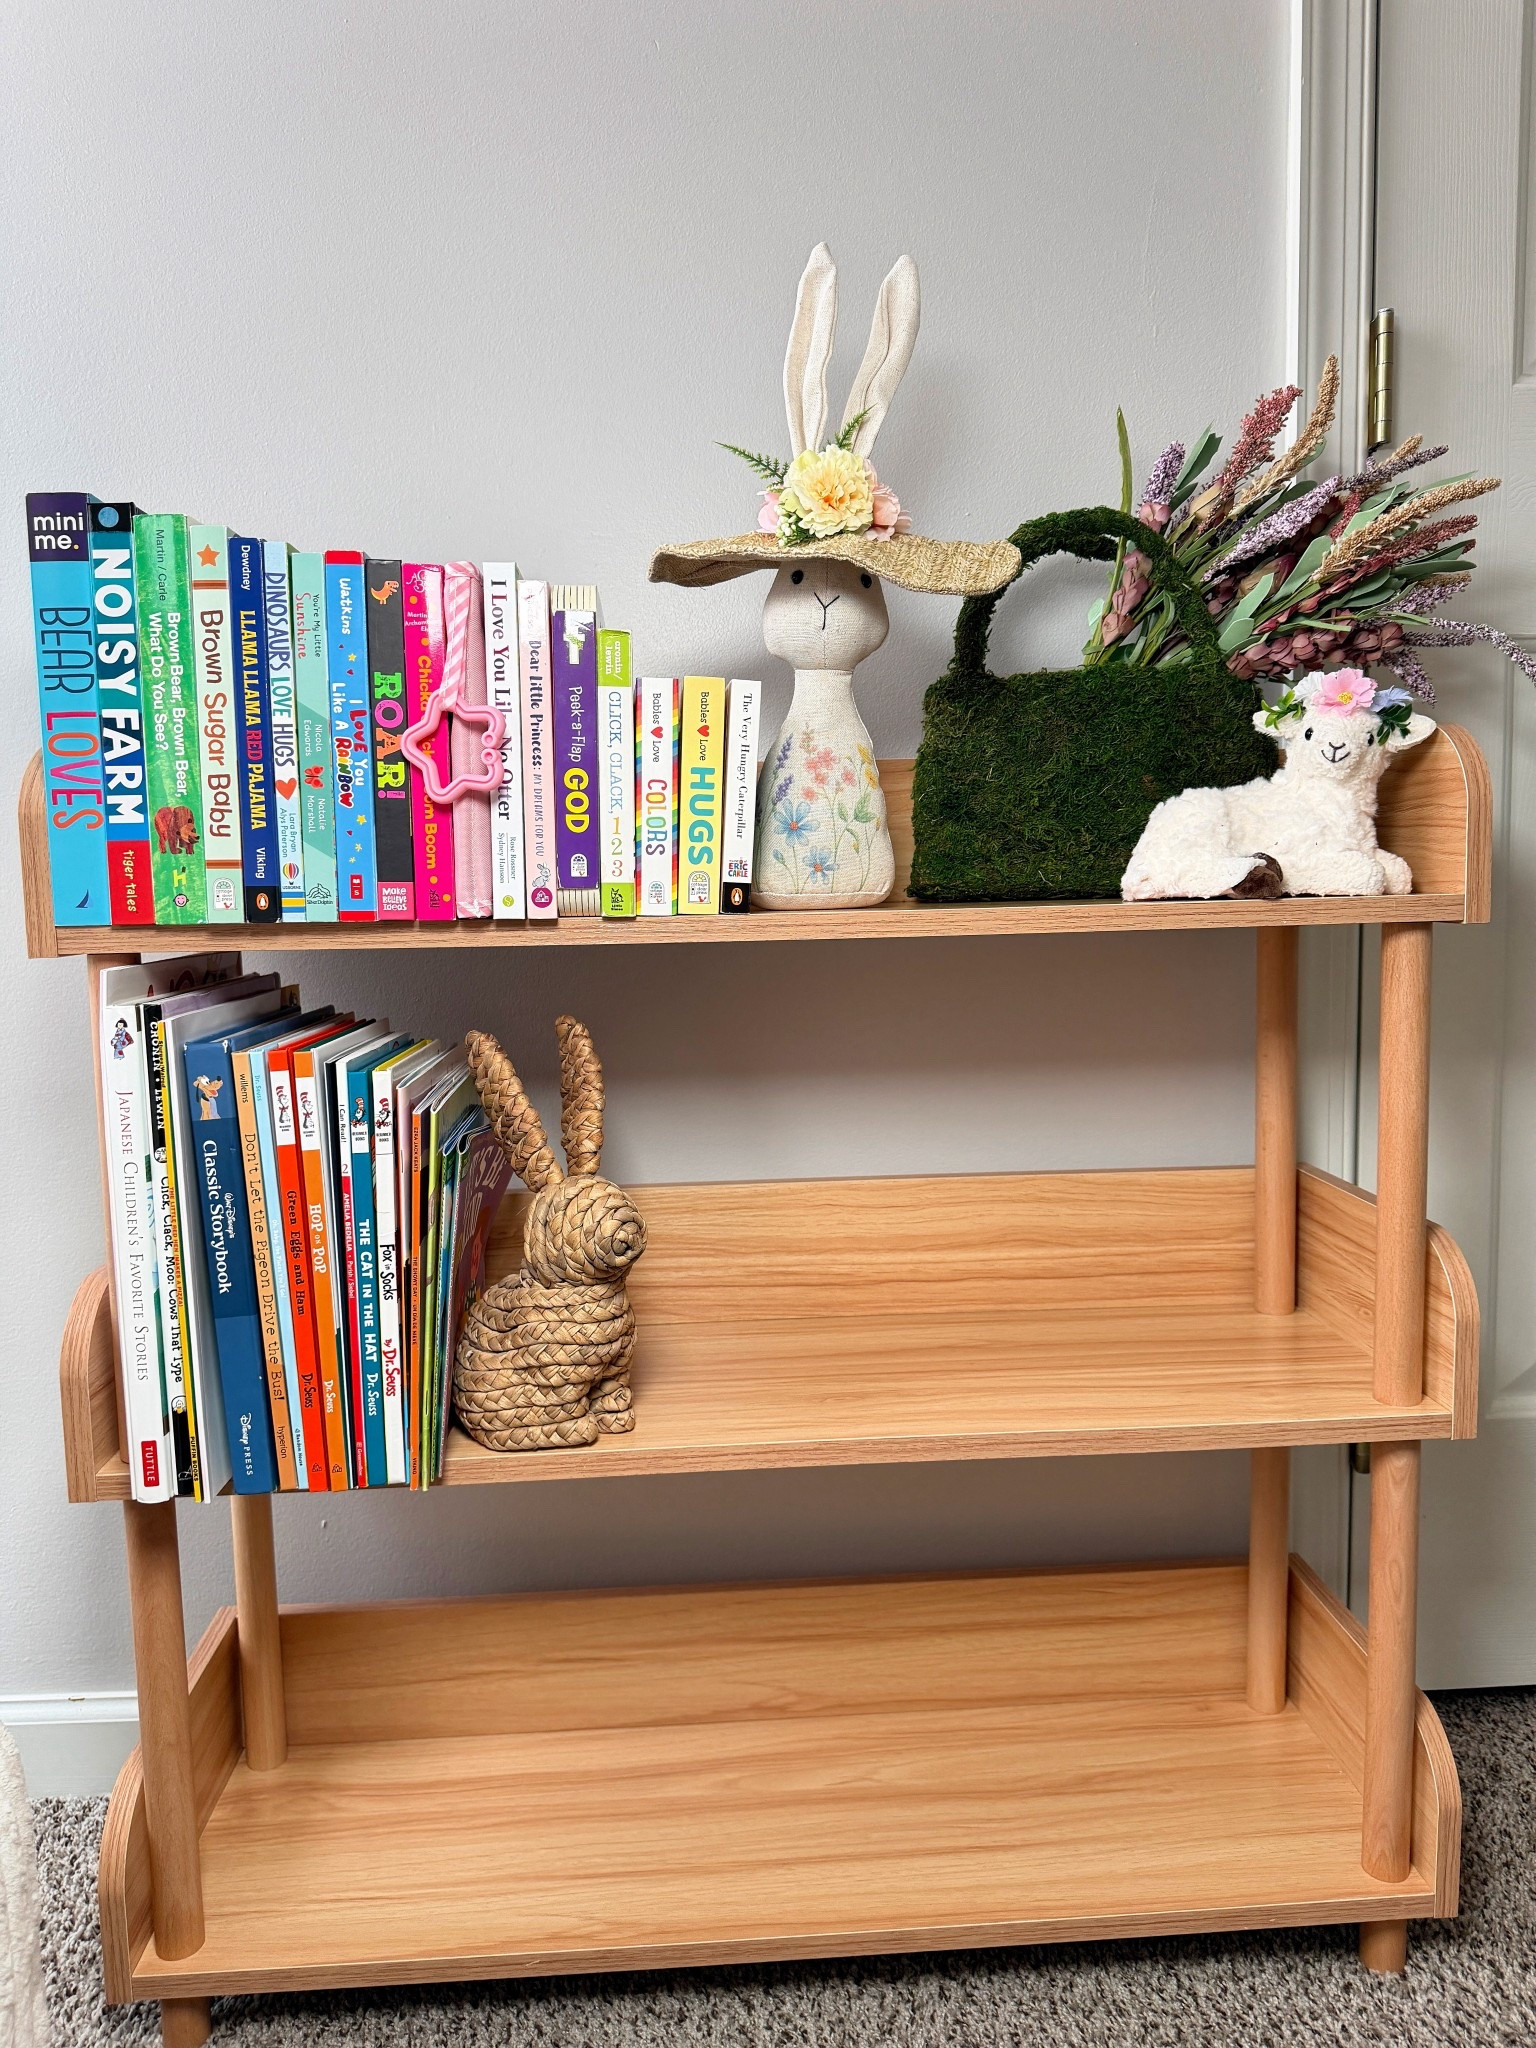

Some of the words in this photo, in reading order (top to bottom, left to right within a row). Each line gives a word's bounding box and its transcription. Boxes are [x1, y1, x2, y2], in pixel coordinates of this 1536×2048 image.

[34, 512, 83, 531] mini
[35, 534, 79, 550] me.
[155, 529, 164, 563] Martin
[241, 545, 250, 590] Dewdney
[491, 579, 507, 587] I
[158, 574, 166, 600] Carle
[265, 573, 291, 671] DINOSAURS
[339, 578, 352, 635] Watkins
[492, 594, 507, 640] Love
[93, 549, 137, 696] NOISY
[149, 612, 161, 652] What
[168, 613, 180, 662] Brown
[296, 592, 311, 659] Sunshine
[312, 621, 320, 632] My
[40, 608, 95, 693] BEAR
[200, 610, 223, 683] Brown
[240, 611, 258, 666] LLAMA
[151, 656, 163, 677] Do
[494, 645, 509, 682] You
[529, 641, 541, 671] Dear
[150, 682, 165, 710] You
[170, 665, 183, 703] Bear,
[243, 670, 261, 726] LLAMA
[271, 677, 292, 718] LOVE
[332, 683, 346, 714] Like
[530, 676, 543, 709] Little
[652, 693, 661, 725] Babies
[700, 692, 709, 723] Babies
[743, 693, 752, 712] The
[154, 714, 169, 750] See?
[173, 708, 185, 755] Brown
[204, 693, 227, 765] Sugar
[335, 720, 349, 730] A
[374, 672, 405, 798] ROAR!
[569, 686, 586, 762] Peek-a-Flap
[608, 692, 622, 748] CLICK,
[738, 716, 752, 741] Very
[246, 730, 262, 760] RED
[273, 724, 295, 766] HUGS
[530, 714, 543, 770] Princess:
[652, 741, 661, 762] Love
[700, 739, 708, 761] Love
[47, 712, 103, 830] LOVES
[102, 709, 144, 824] FARM
[176, 760, 188, 797] Bear,
[355, 759, 368, 785] You
[737, 745, 750, 783] Hungry
[534, 775, 542, 785] MY
[608, 753, 622, 813] CLACK,
[208, 774, 232, 837] Baby
[248, 764, 266, 830] PAJAMA
[534, 788, 543, 822] DREAMS
[564, 768, 589, 833] GOD
[735, 786, 748, 838] Caterpillar
[308, 795, 316, 832] Marshall
[318, 799, 326, 830] Natalie
[646, 779, 668, 855] COLORS
[688, 767, 716, 865] HUGS
[425, 823, 437, 869] Boom
[497, 832, 506, 857] Sydney
[535, 825, 543, 838] FOR
[611, 838, 622, 855] 2
[256, 848, 266, 878] Viking
[536, 841, 544, 856] YOU
[122, 849, 134, 880] tiger
[612, 860, 622, 877] 3
[125, 883, 137, 912] tales
[150, 1022, 161, 1072] CRONIN
[240, 1074, 248, 1103] willems
[115, 1091, 133, 1155] JAPANESE
[154, 1089, 165, 1130] LEWIN
[244, 1134, 259, 1174] Don't
[342, 1164, 348, 1174] 2
[203, 1140, 221, 1200] Classic
[124, 1162, 144, 1246] CHILDREN'S
[161, 1176, 170, 1210] Click,
[250, 1180, 261, 1204] Let
[287, 1191, 296, 1224] Green
[343, 1193, 351, 1220] AMELIA
[164, 1215, 172, 1251] Clack,
[253, 1210, 264, 1233] the
[309, 1204, 323, 1232] HOP
[359, 1219, 371, 1246] THE
[210, 1204, 232, 1294] Storybook
[290, 1231, 302, 1259] Eggs
[345, 1221, 353, 1252] BEDELIA
[254, 1240, 270, 1288] Pigeon
[313, 1247, 326, 1273] POP
[361, 1252, 373, 1278] CAT
[380, 1244, 395, 1262] Fox
[130, 1254, 144, 1318] FAVORITE
[166, 1256, 176, 1285] Moo:
[294, 1264, 304, 1285] and
[380, 1272, 397, 1300] Socks
[168, 1290, 178, 1320] Cows
[295, 1290, 305, 1315] Ham
[363, 1284, 372, 1298] IN
[262, 1295, 275, 1335] Drive
[364, 1303, 374, 1327] THE
[171, 1323, 182, 1351] That
[269, 1341, 279, 1364] the
[365, 1334, 377, 1362] HAT
[384, 1338, 392, 1347] by
[134, 1326, 150, 1380] STORIES
[171, 1354, 183, 1382] Type
[383, 1348, 396, 1367] Dr.
[271, 1371, 284, 1400] Bus!
[302, 1373, 313, 1386] Dr.
[324, 1380, 333, 1393] Dr.
[367, 1373, 378, 1389] Dr.
[386, 1368, 400, 1397] Seuss
[304, 1388, 316, 1408] Seuss
[326, 1393, 336, 1413] Seuss
[368, 1391, 379, 1416] Seuss
[239, 1413, 252, 1445] Disney
[278, 1426, 287, 1458] hyperion
[145, 1446, 155, 1481] TUTTLE
[244, 1447, 253, 1475] PRESS
